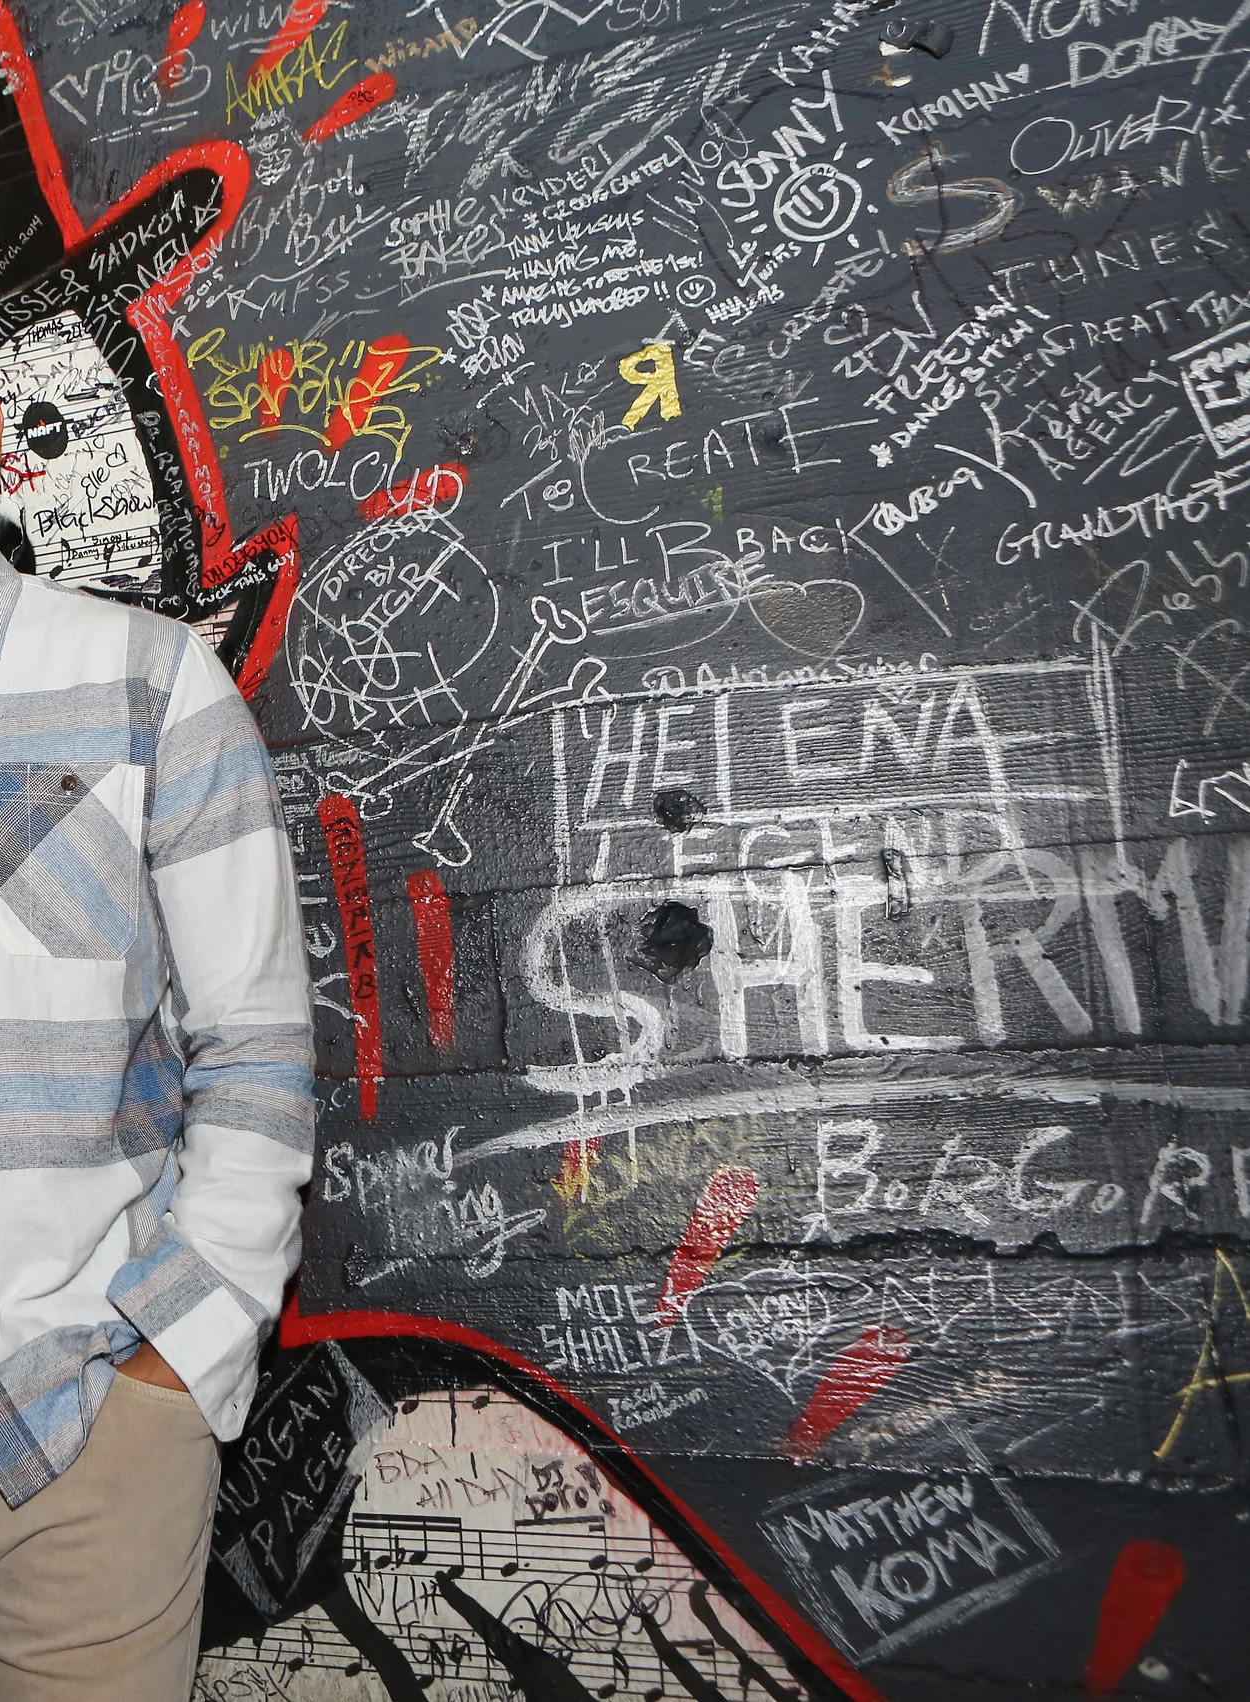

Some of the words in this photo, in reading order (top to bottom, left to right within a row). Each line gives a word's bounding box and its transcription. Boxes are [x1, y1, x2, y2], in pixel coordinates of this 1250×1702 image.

[716, 68, 844, 209] SONNY
[18, 215, 43, 246] 2014
[993, 209, 1230, 300] TUNES
[26, 318, 64, 347] THOMAS
[27, 422, 63, 439] NAFT
[81, 466, 110, 499] Elle
[244, 449, 465, 520] TWOLOUD
[195, 585, 235, 606] FUCK
[267, 549, 296, 574] GUY
[365, 556, 396, 589] BY
[541, 536, 639, 588] I'LL
[581, 674, 1012, 815] HELENA
[373, 1447, 450, 1486] BDA
[251, 1430, 347, 1582] PAGE
[783, 1475, 975, 1569] MATTHEW
[829, 1510, 1029, 1635] KOMA
